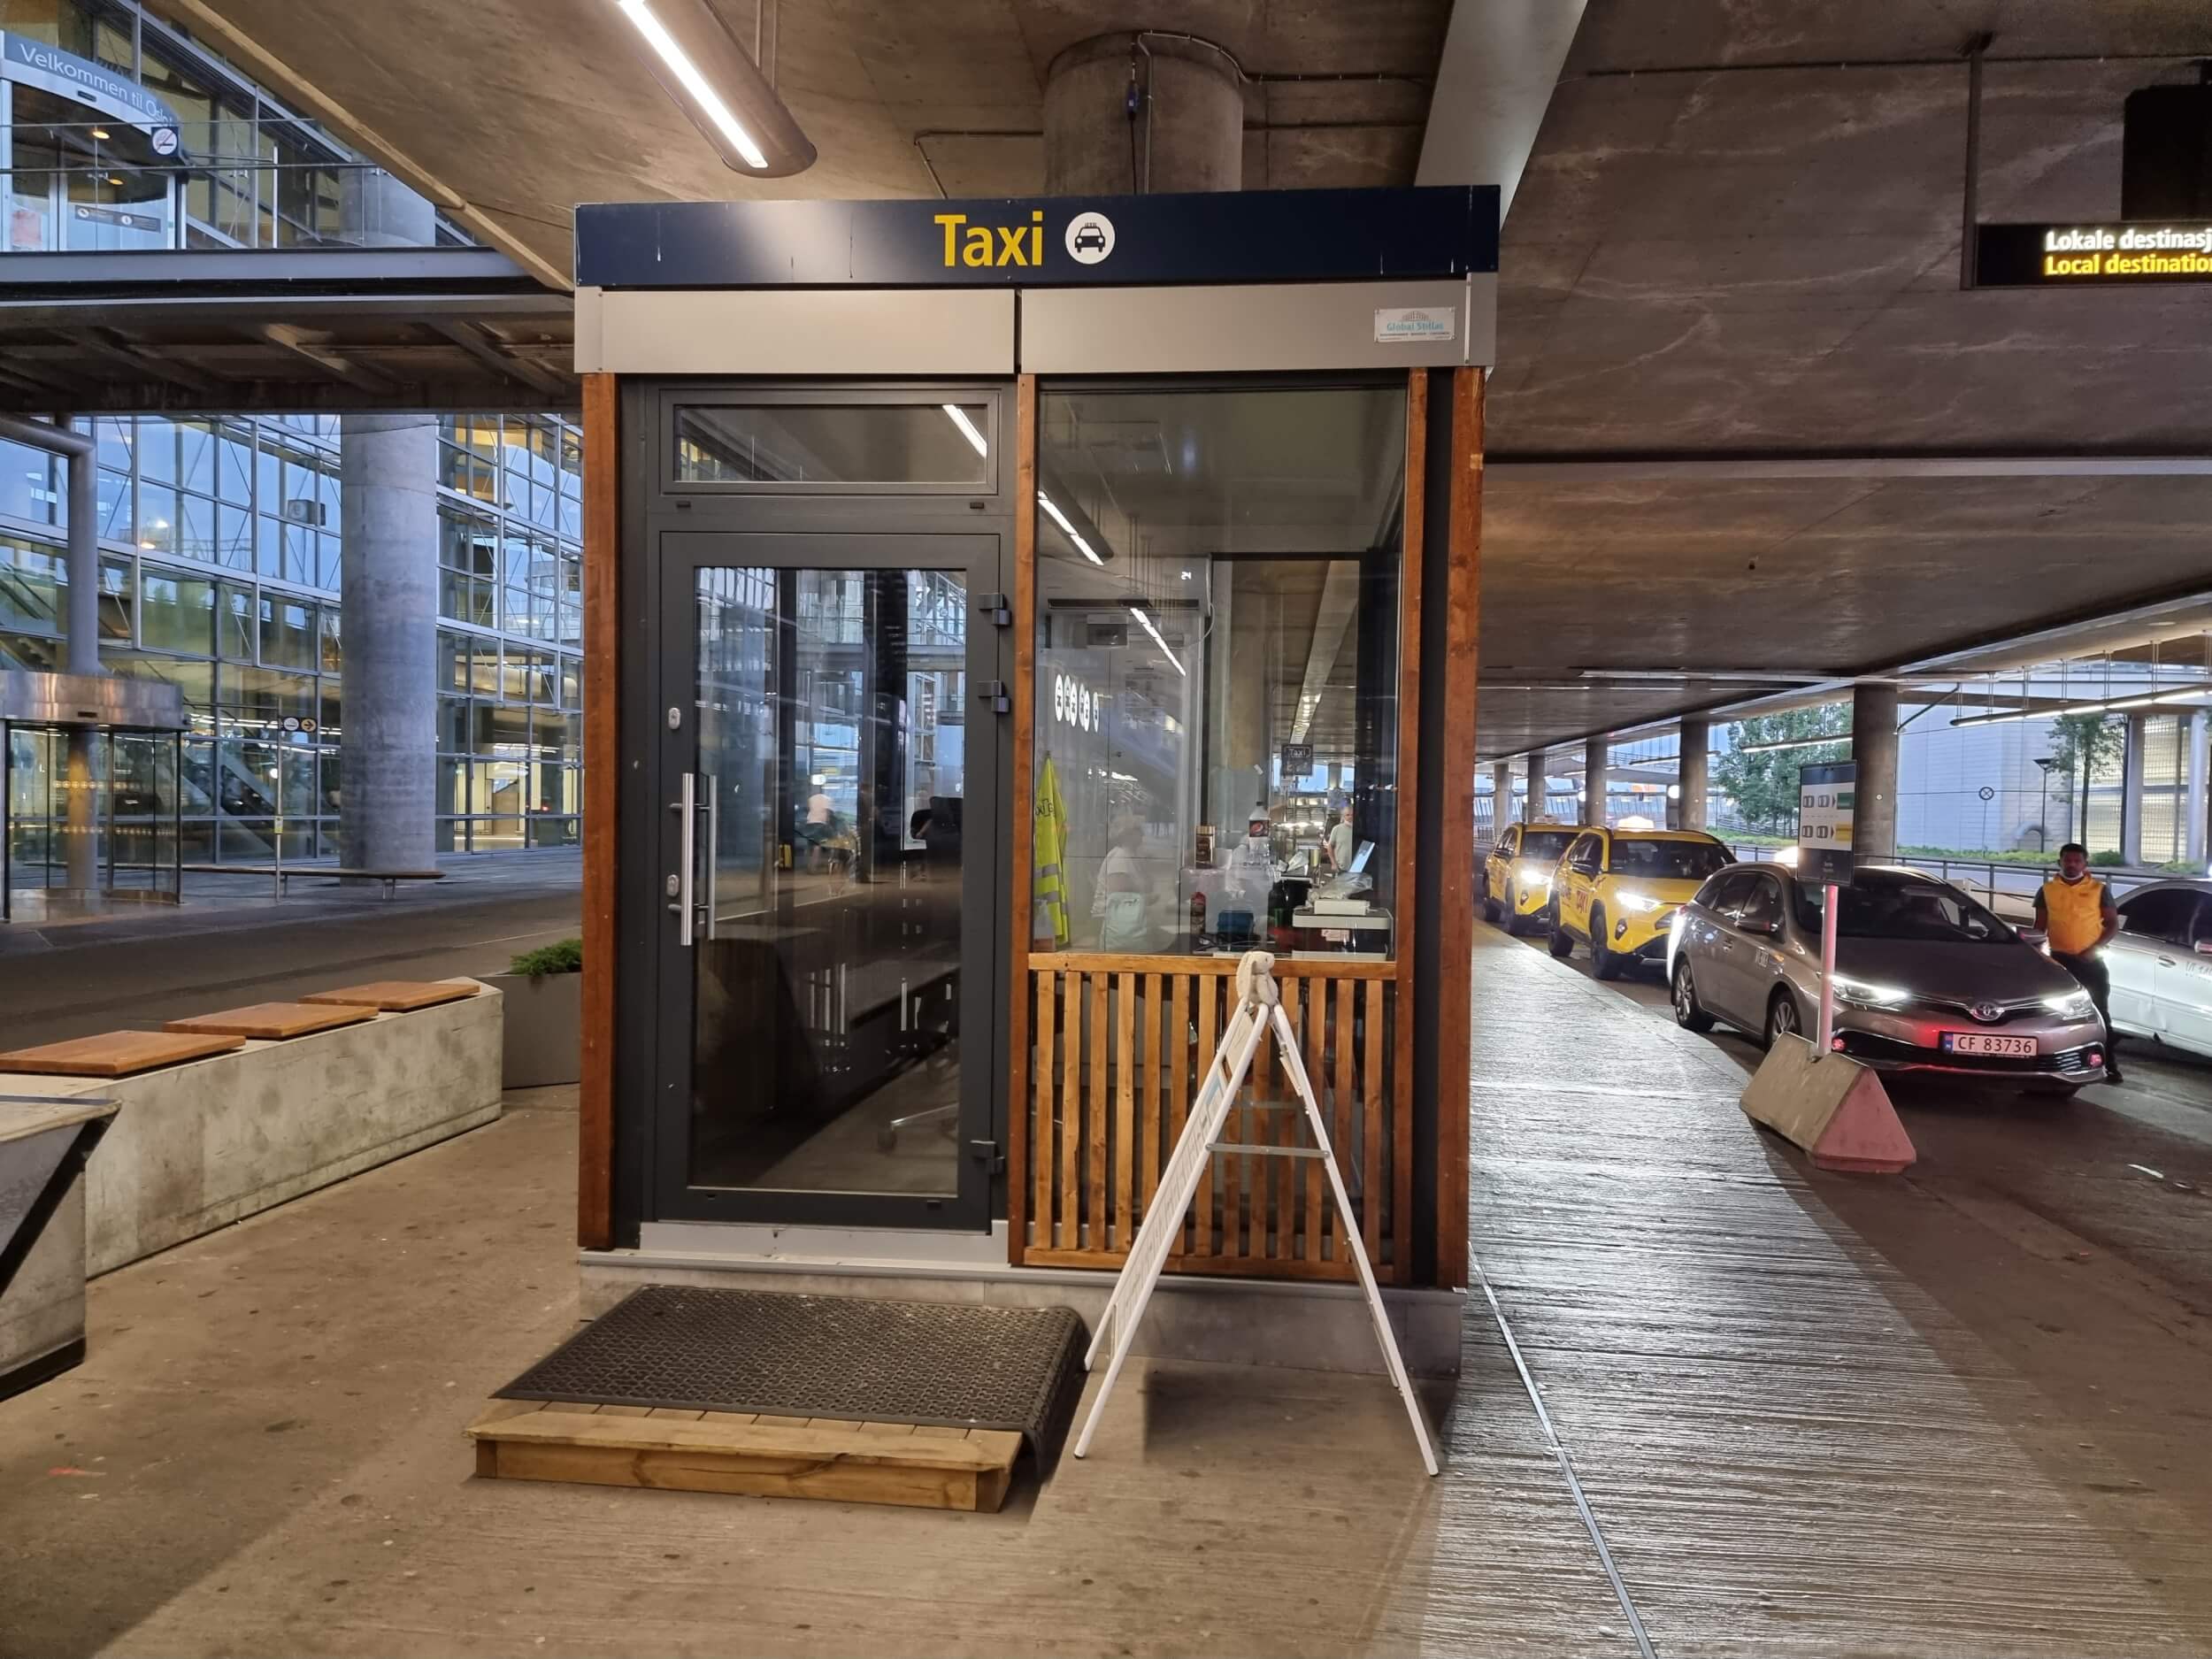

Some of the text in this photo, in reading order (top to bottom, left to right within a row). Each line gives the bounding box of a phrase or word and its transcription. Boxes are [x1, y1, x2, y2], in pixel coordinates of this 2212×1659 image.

[19, 43, 127, 101] Velkommen
[131, 90, 143, 109] til
[934, 211, 1043, 266] Taxi
[2045, 227, 2212, 254] Lokale destinasj
[2045, 253, 2101, 276] Local
[1958, 1036, 2032, 1054] CF 83736
